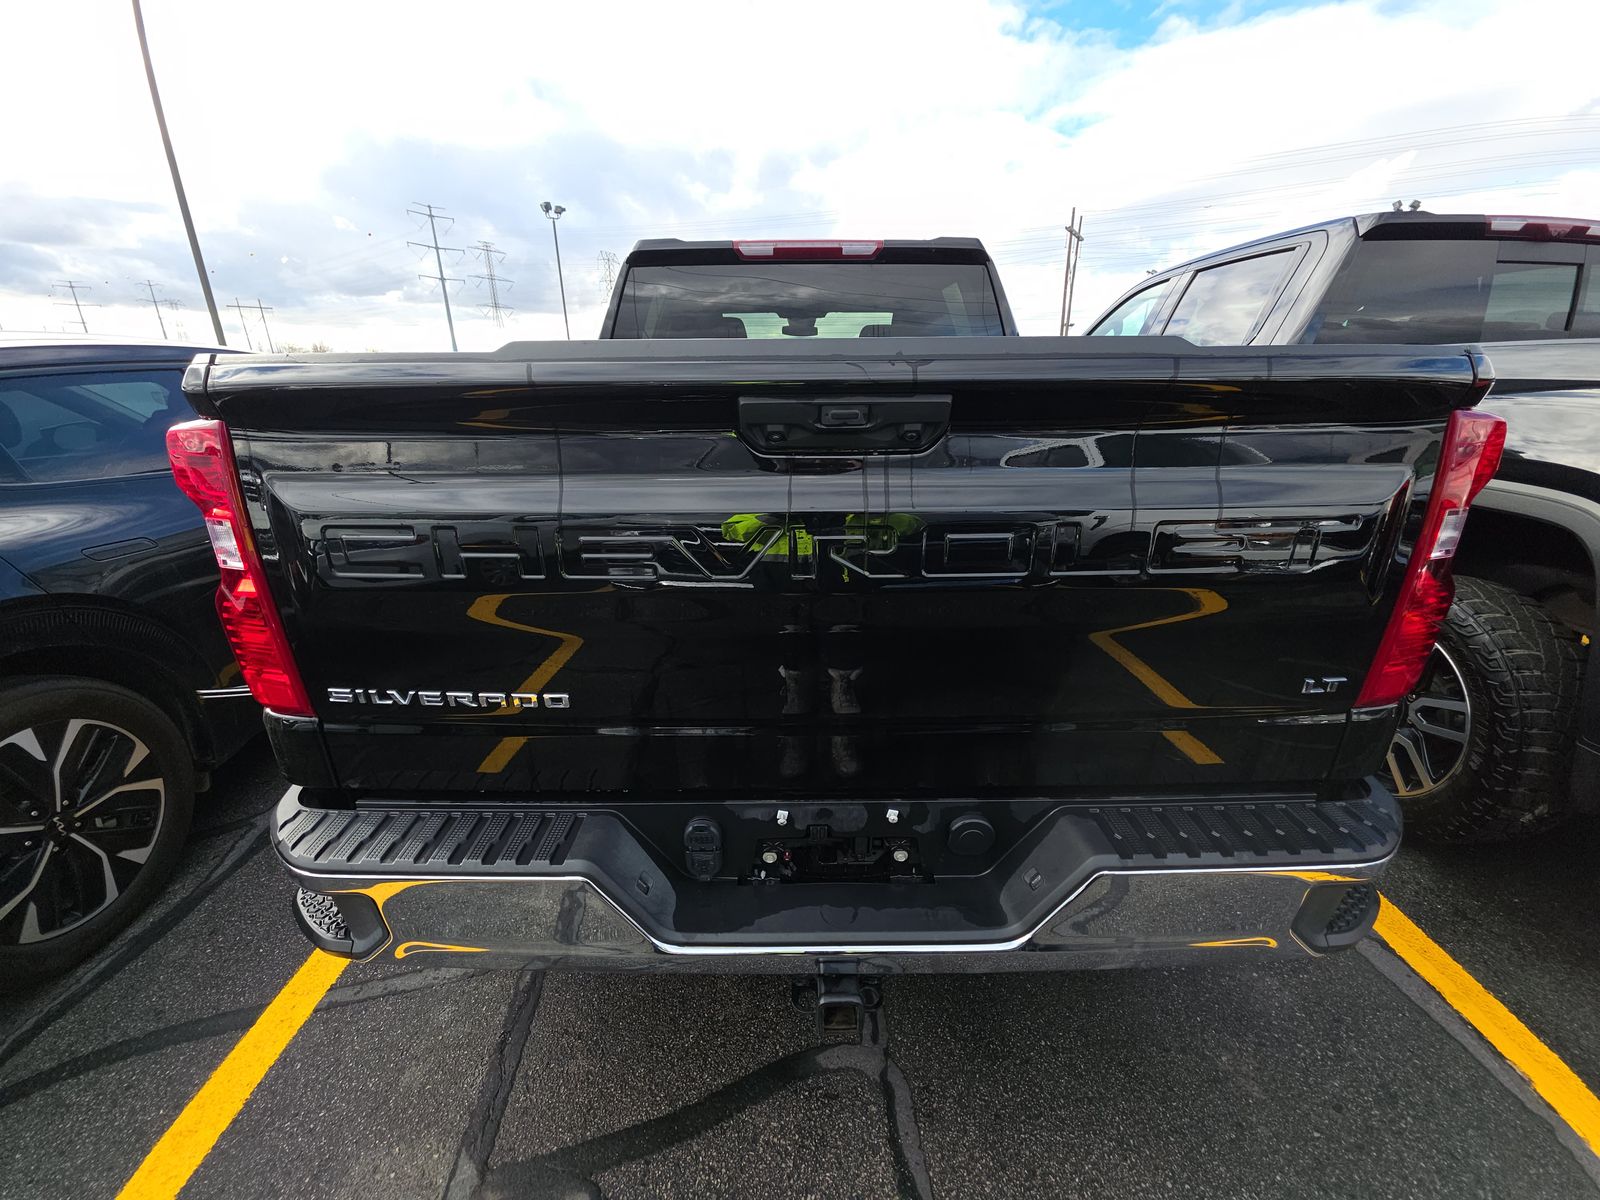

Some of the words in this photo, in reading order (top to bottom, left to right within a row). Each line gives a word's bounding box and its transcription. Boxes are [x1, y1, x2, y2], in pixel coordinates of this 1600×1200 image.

[320, 515, 1364, 581] CHEVROLET
[1301, 677, 1348, 694] LT
[327, 687, 571, 709] SILVERADO
